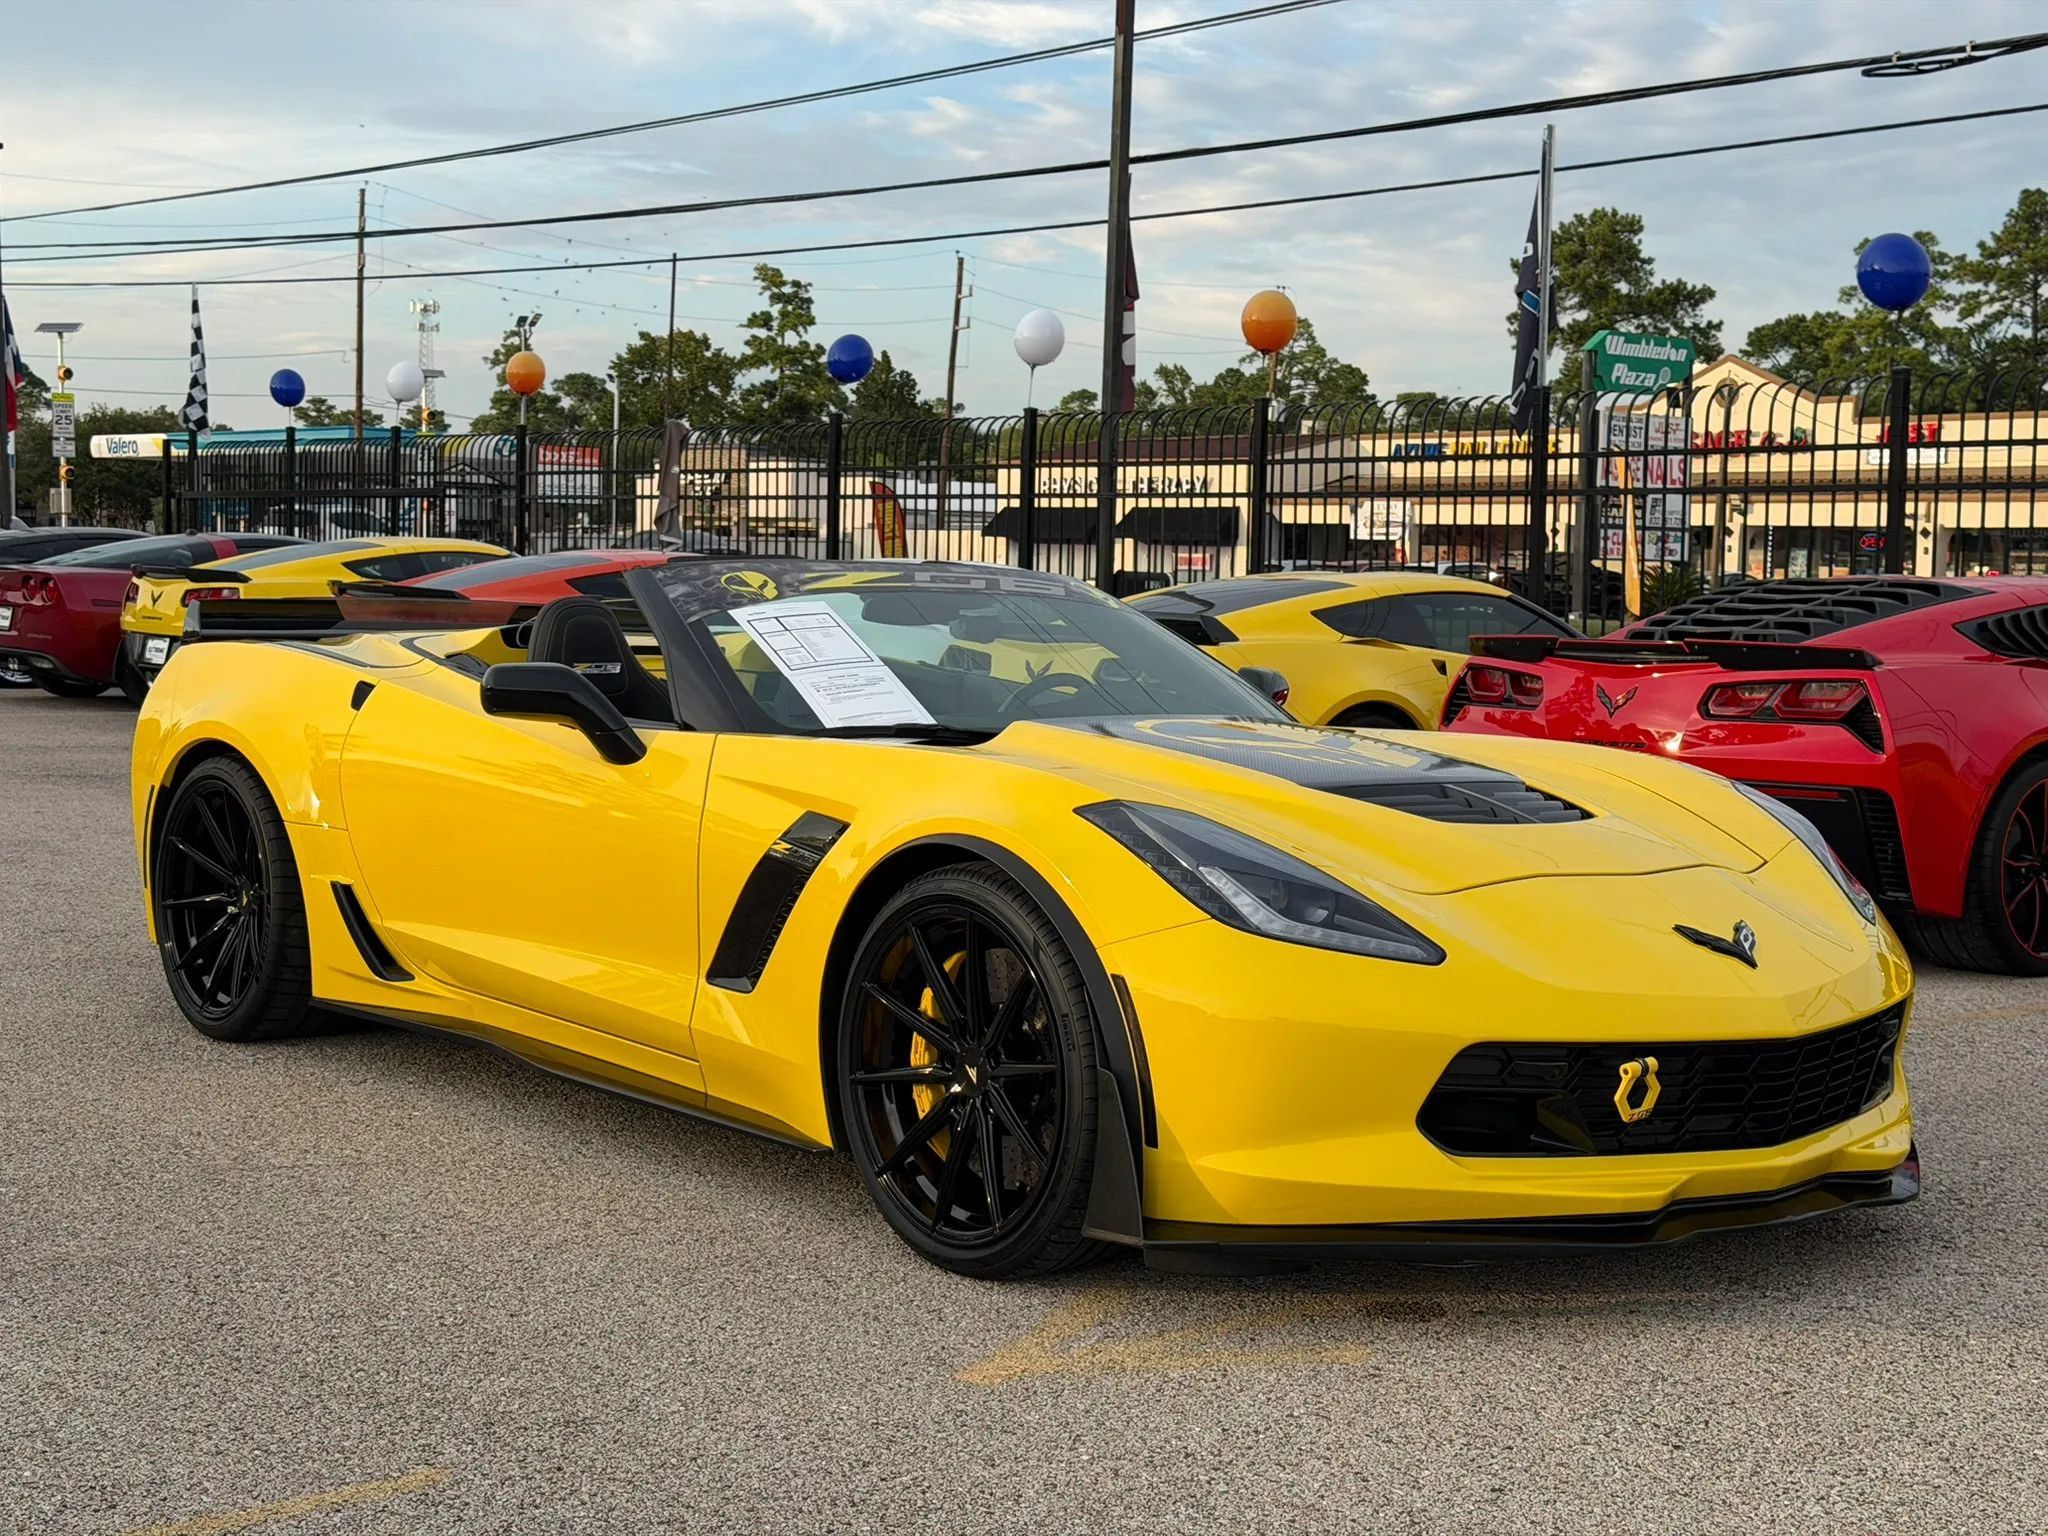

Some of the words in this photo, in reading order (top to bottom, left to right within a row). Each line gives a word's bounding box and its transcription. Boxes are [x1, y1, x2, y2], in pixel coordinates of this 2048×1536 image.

[1605, 335, 1688, 362] Wimbledon
[1611, 363, 1657, 387] Plaza
[55, 414, 73, 426] 25
[1607, 423, 1644, 439] ENTST
[1875, 422, 1939, 444] JST
[106, 437, 139, 454] Valero
[1648, 457, 1686, 487] NALS
[801, 571, 1067, 597] Z06
